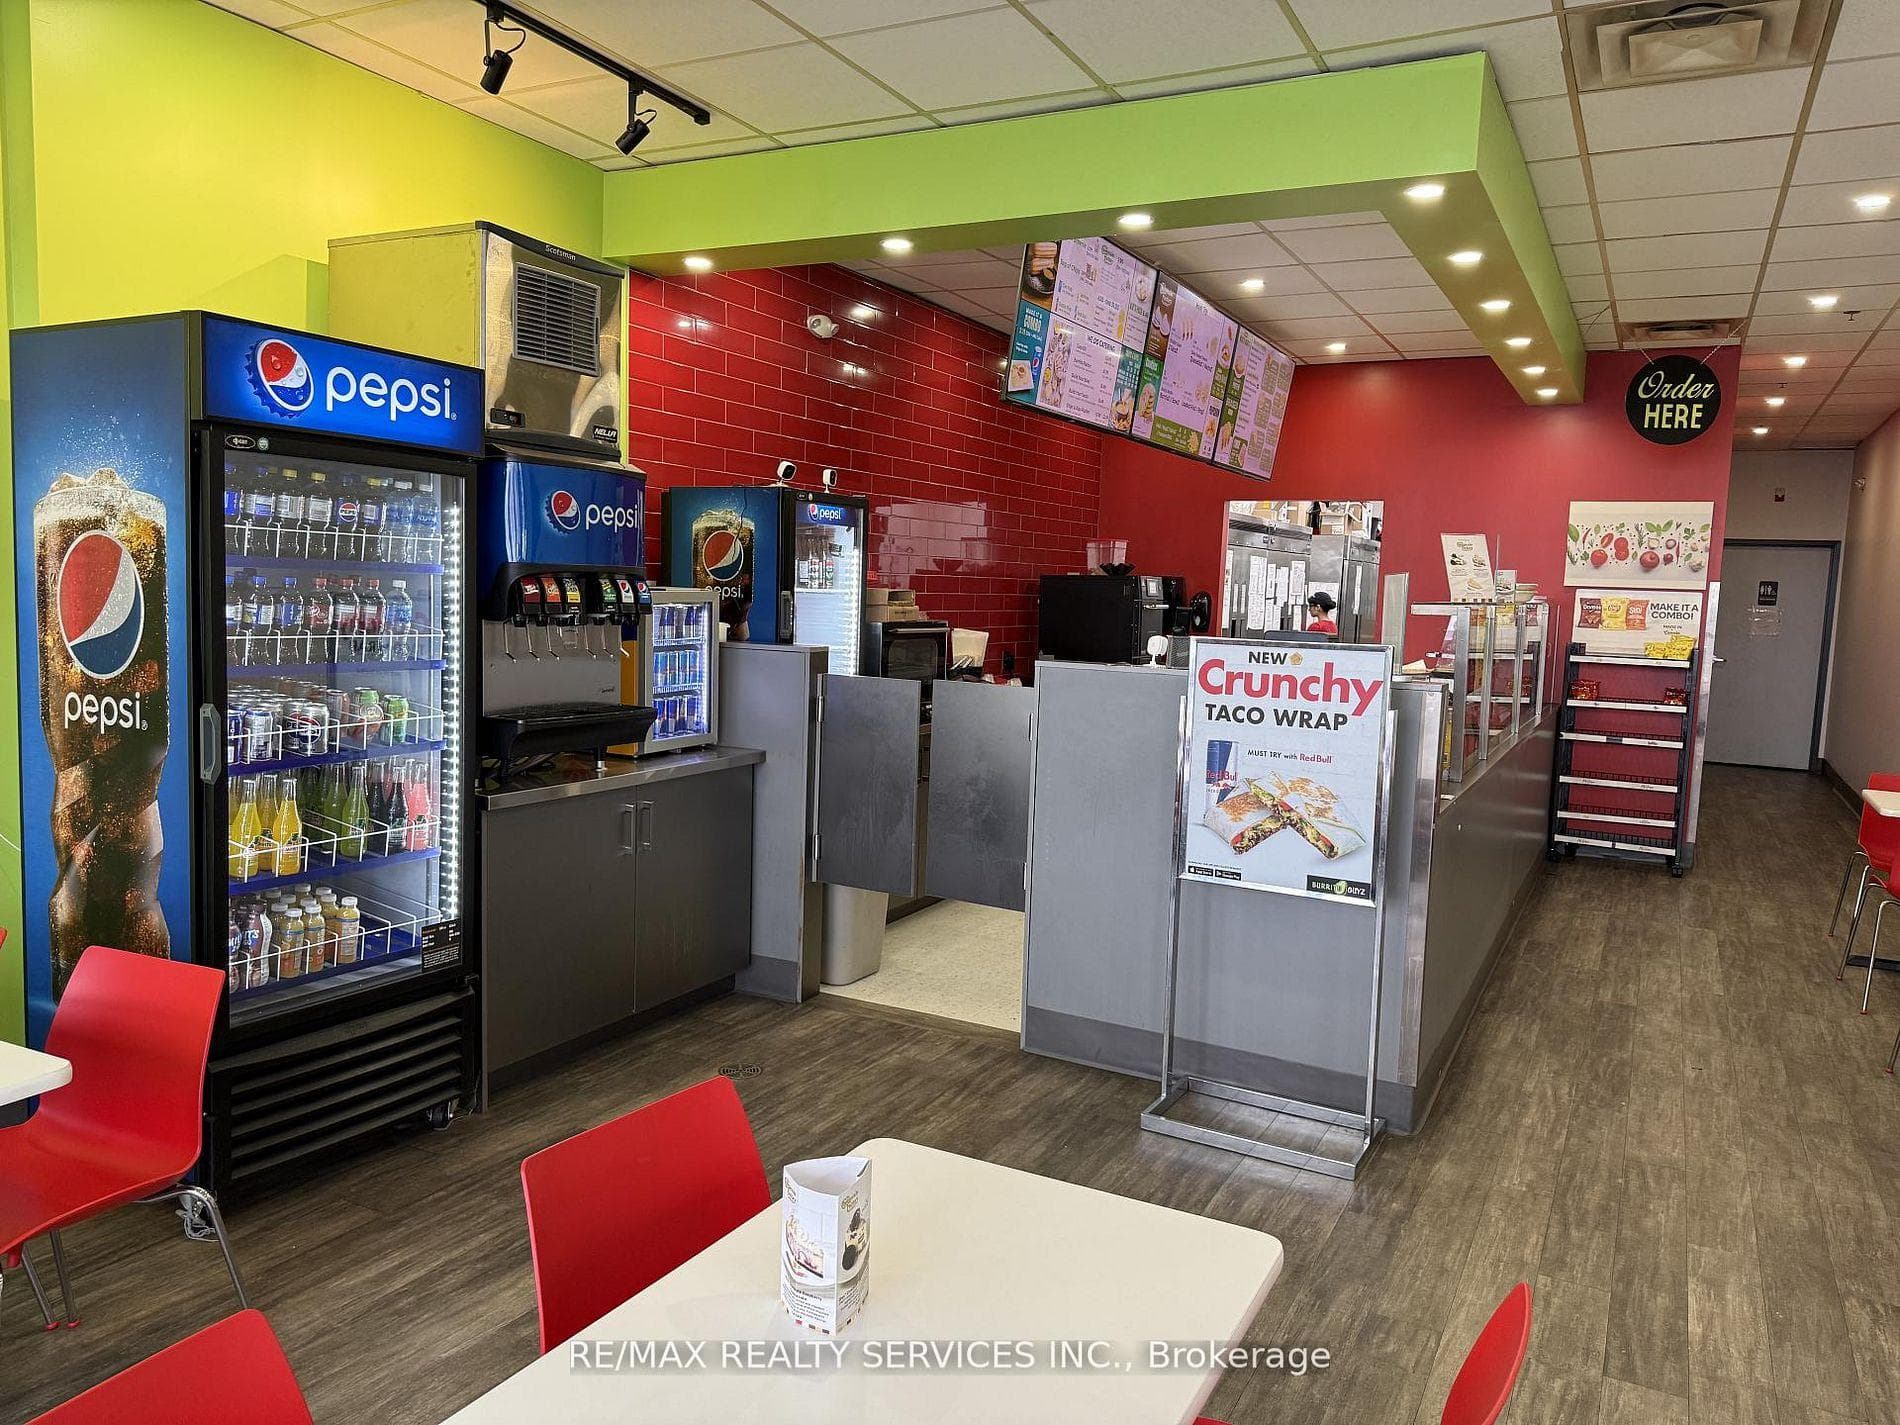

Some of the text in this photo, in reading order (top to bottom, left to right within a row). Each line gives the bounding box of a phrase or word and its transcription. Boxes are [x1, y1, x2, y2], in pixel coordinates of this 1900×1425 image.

[545, 245, 576, 261] Scotsman
[326, 366, 452, 422] pepsi
[1637, 370, 1715, 400] Order
[1643, 403, 1704, 430] HERE
[585, 502, 639, 533] pepsi
[819, 508, 842, 521] pepsi
[1650, 602, 1680, 611] MAKE
[1691, 604, 1699, 612] A
[1651, 611, 1694, 620] COMBO!
[1248, 651, 1288, 665] NEW
[1197, 658, 1383, 717] Crunchy
[64, 691, 141, 734] pepsi
[1205, 703, 1348, 731] TACO WRAP
[1247, 749, 1268, 758] MUST
[1269, 751, 1282, 759] TRY
[1347, 886, 1366, 896] GUYZ
